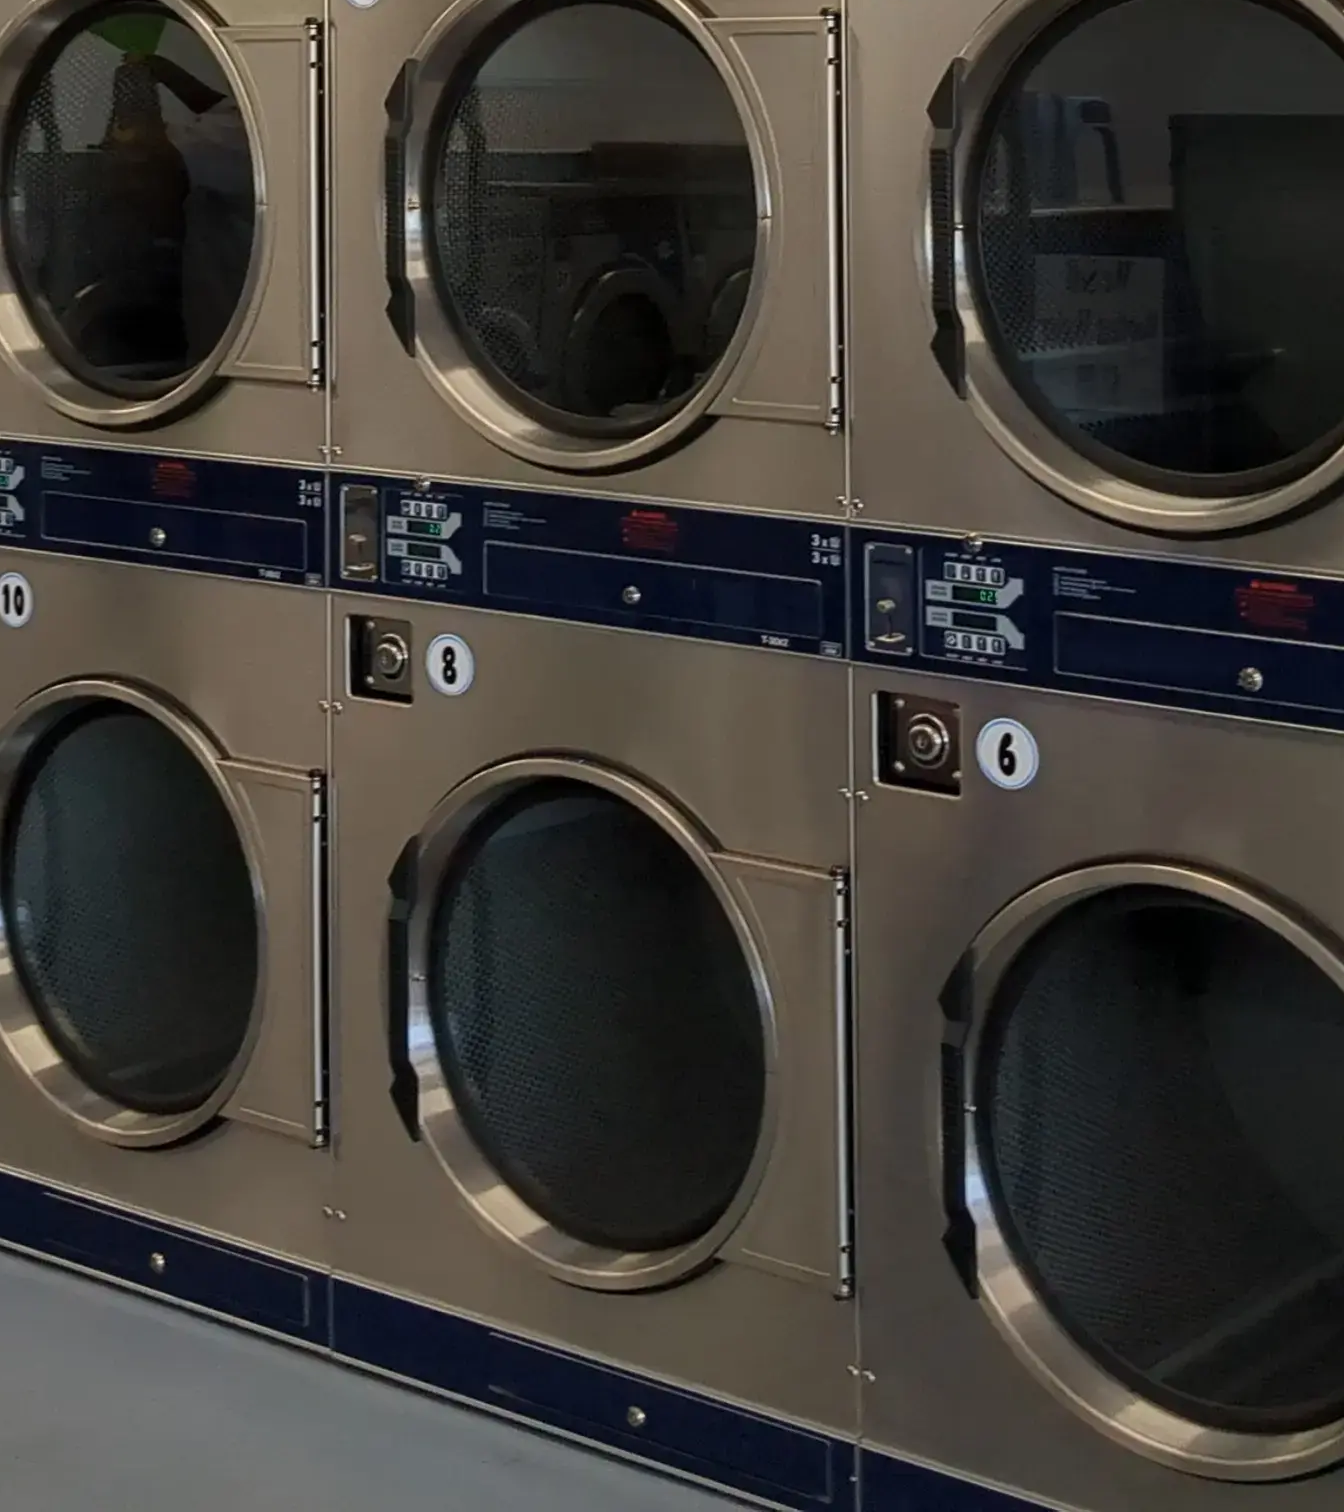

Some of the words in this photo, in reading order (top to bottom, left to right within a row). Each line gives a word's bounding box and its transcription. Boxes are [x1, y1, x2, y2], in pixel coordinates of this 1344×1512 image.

[2, 583, 24, 617] 10
[442, 645, 457, 685] 8
[997, 732, 1019, 776] 6
